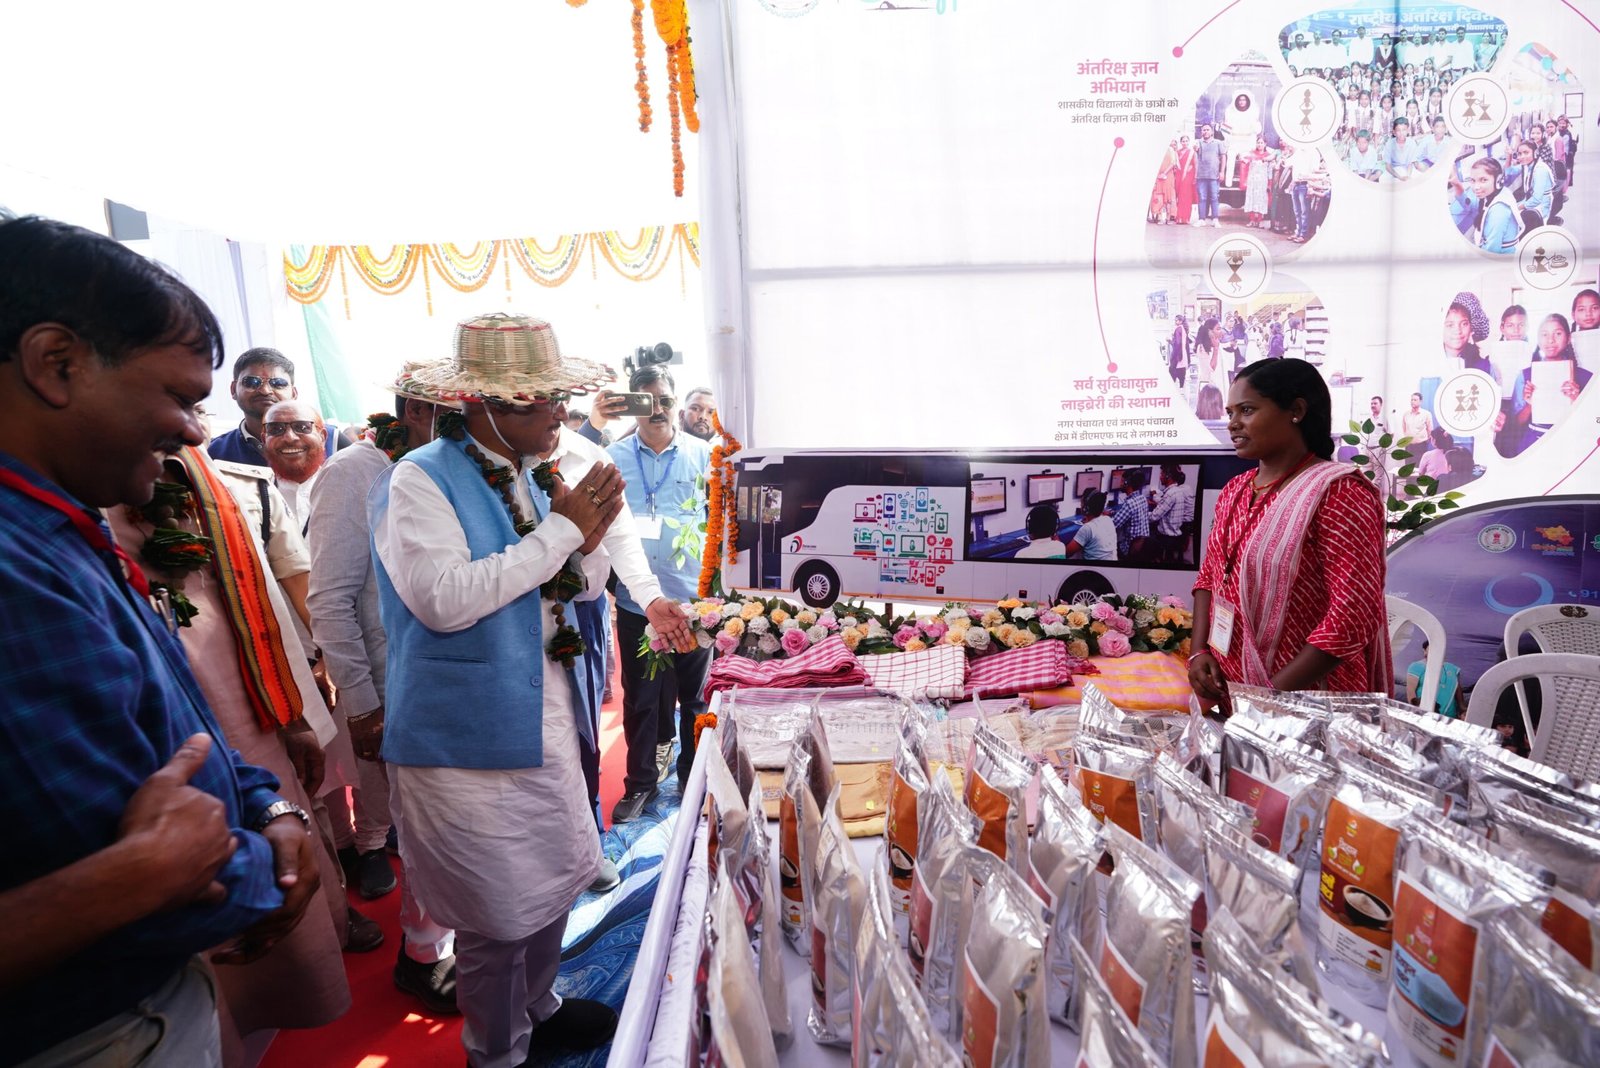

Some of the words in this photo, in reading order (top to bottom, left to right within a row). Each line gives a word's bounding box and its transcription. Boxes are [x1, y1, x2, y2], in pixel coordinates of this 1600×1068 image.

[1400, 8, 1453, 23] अंतरिक्ष
[1077, 58, 1128, 76] अंतरिक्ष
[1130, 62, 1159, 77] ज्ञान
[1090, 77, 1147, 94] अभियान
[1058, 98, 1094, 109] शासकीय
[1096, 98, 1132, 109] विद्यालयों
[1135, 98, 1143, 108] के
[1145, 97, 1166, 108] छात्रों
[1167, 97, 1179, 108] को
[1071, 113, 1101, 124] अंतरिक्ष
[1103, 112, 1128, 124] विज्ञान
[1130, 112, 1142, 123] की
[1144, 112, 1167, 123] शिक्षा
[1073, 376, 1094, 391] सर्व
[1096, 376, 1159, 394] सुविधायुक्त
[1061, 395, 1105, 412] लाइब्रेरी
[1108, 395, 1125, 409] की
[1127, 397, 1172, 409] स्थापना
[1057, 420, 1074, 428] नगर
[1076, 418, 1104, 428] पंचायत
[1106, 417, 1118, 427] एवं
[1120, 418, 1145, 427] जनपद
[1147, 416, 1175, 426] पंचायत
[1054, 431, 1069, 441] क्षेत्र
[1080, 430, 1114, 440] डीएमएफ
[1116, 431, 1128, 440] मद
[1130, 429, 1138, 439] से
[1139, 430, 1165, 439] लगभग
[1166, 430, 1178, 438] 83
